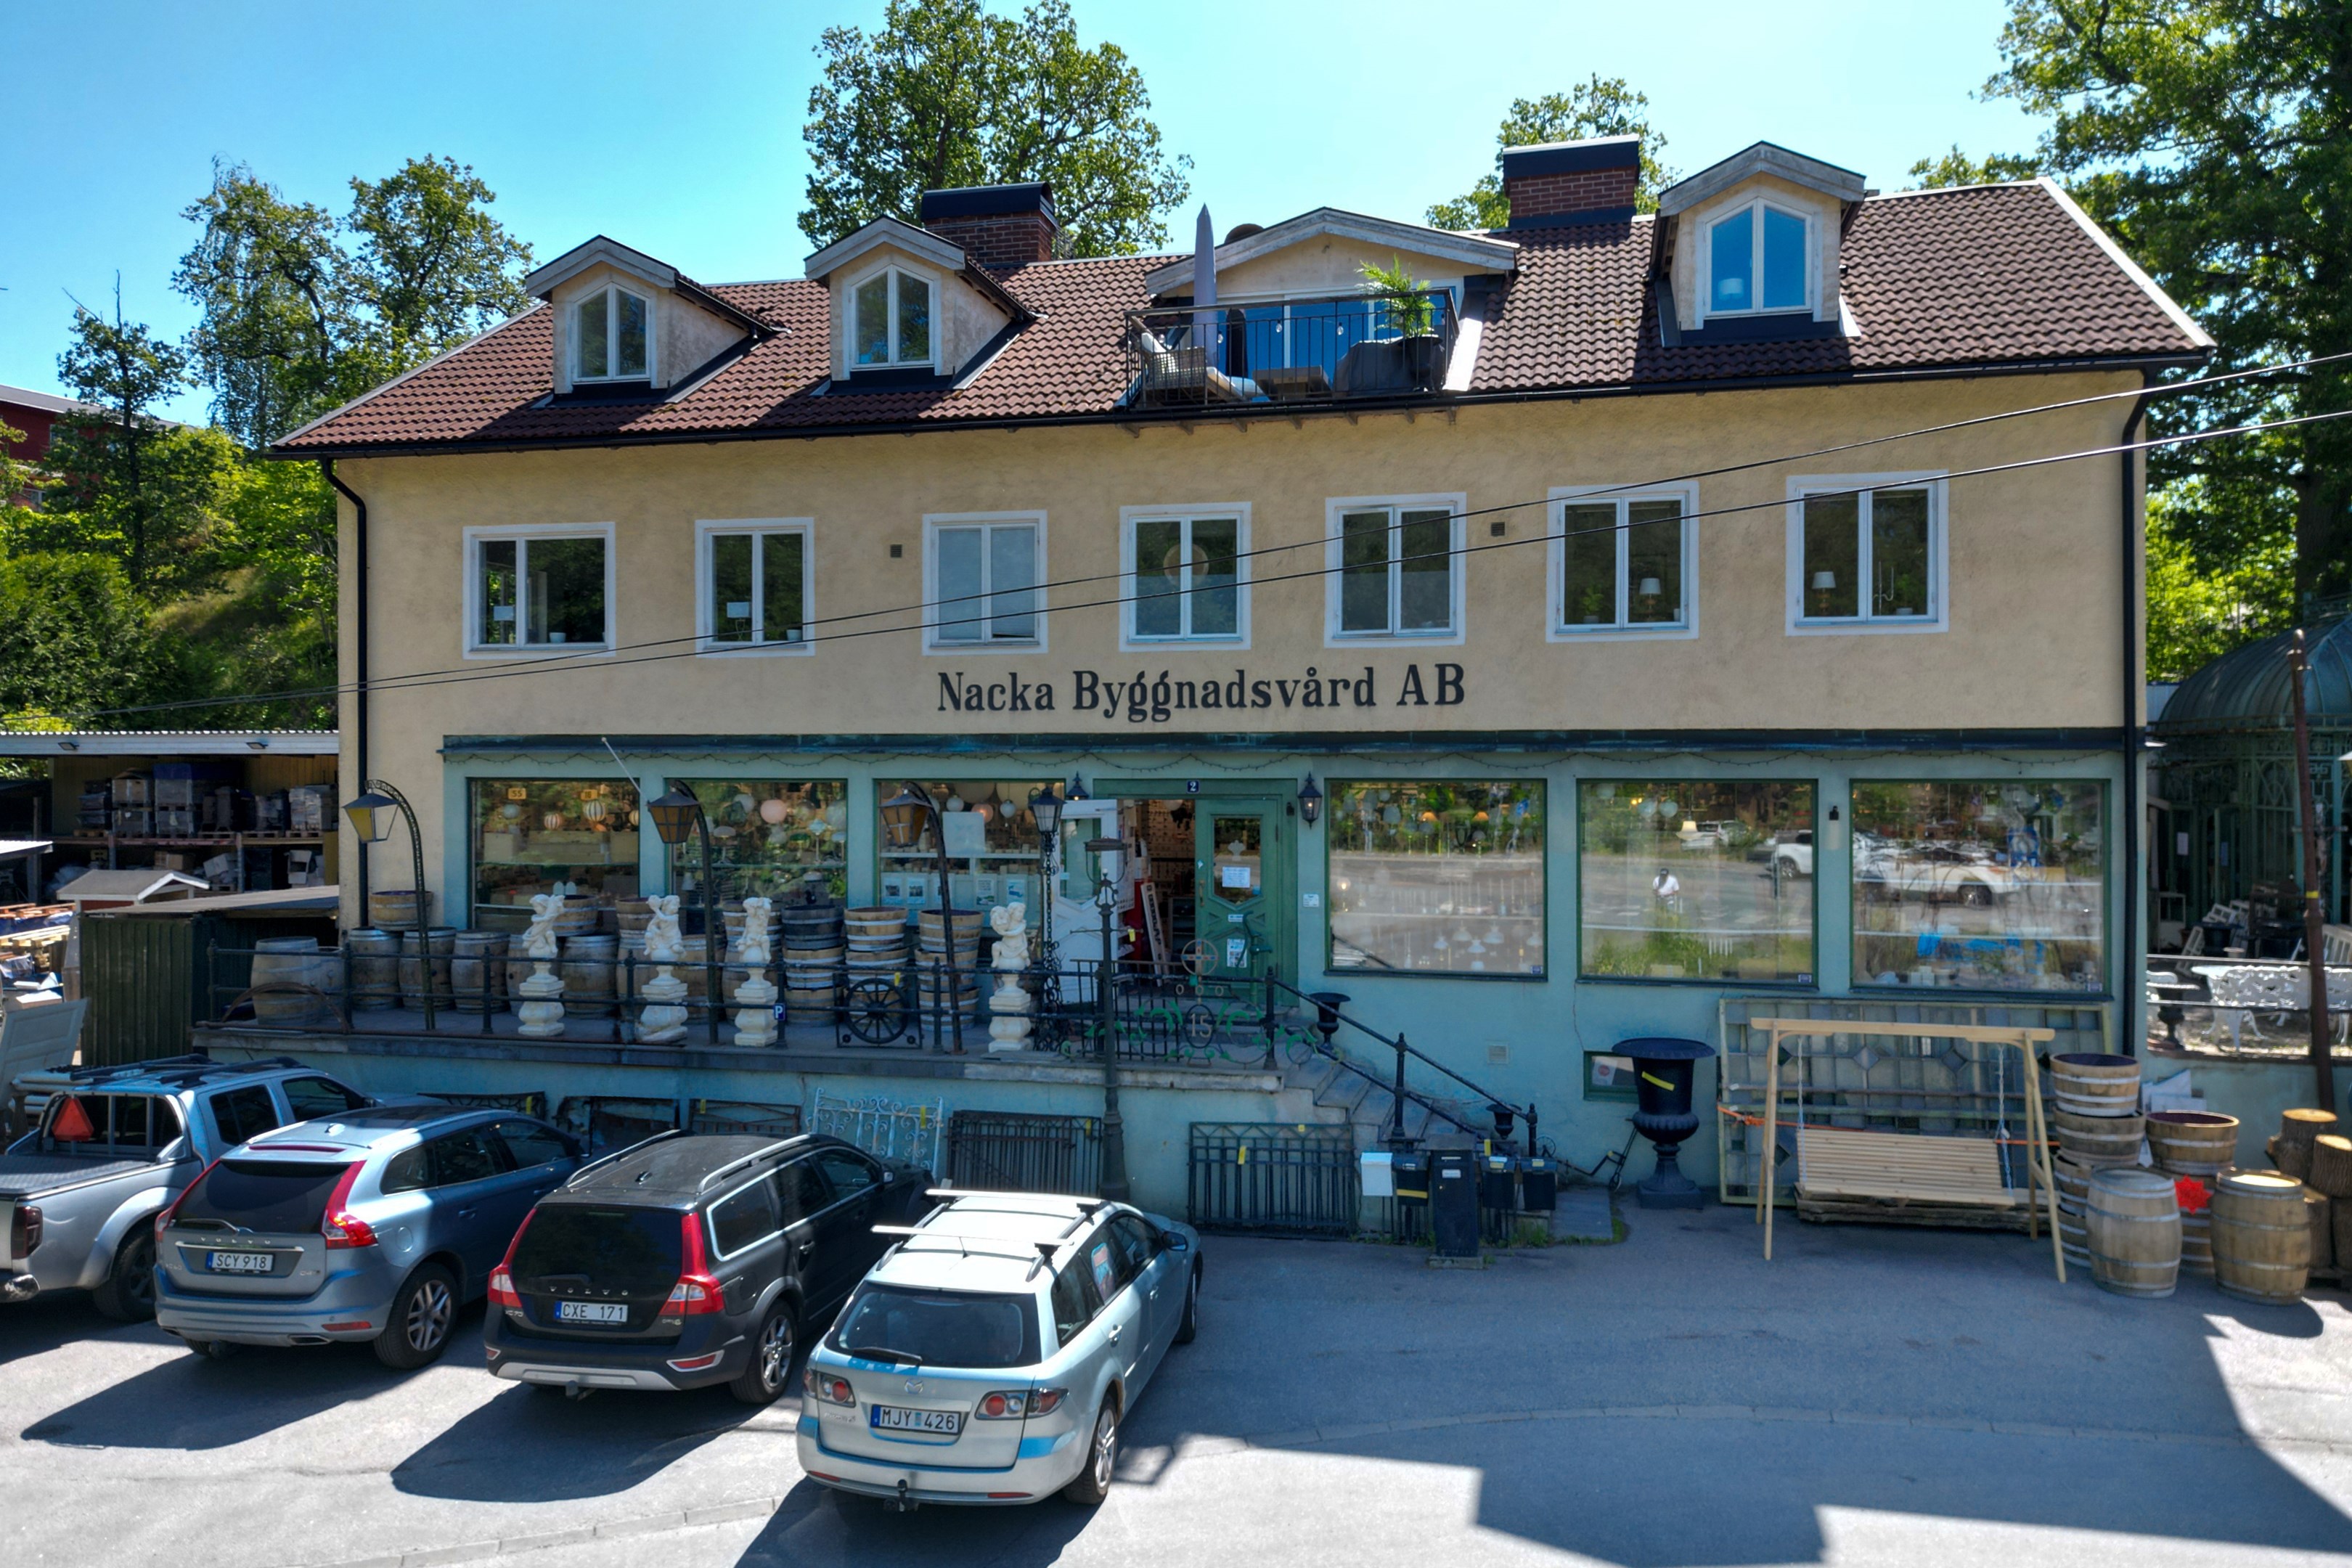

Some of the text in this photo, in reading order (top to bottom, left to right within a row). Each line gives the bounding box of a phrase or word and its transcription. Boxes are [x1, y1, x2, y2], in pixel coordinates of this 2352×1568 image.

[937, 662, 1466, 722] Nacka Byggnadsvård AB
[1190, 781, 1196, 791] 2
[775, 1005, 783, 1018] P
[216, 1254, 267, 1269] SCY 918
[549, 1286, 629, 1296] VOLVO
[562, 1304, 624, 1320] CXE 171
[881, 1409, 955, 1431] MJY 426
